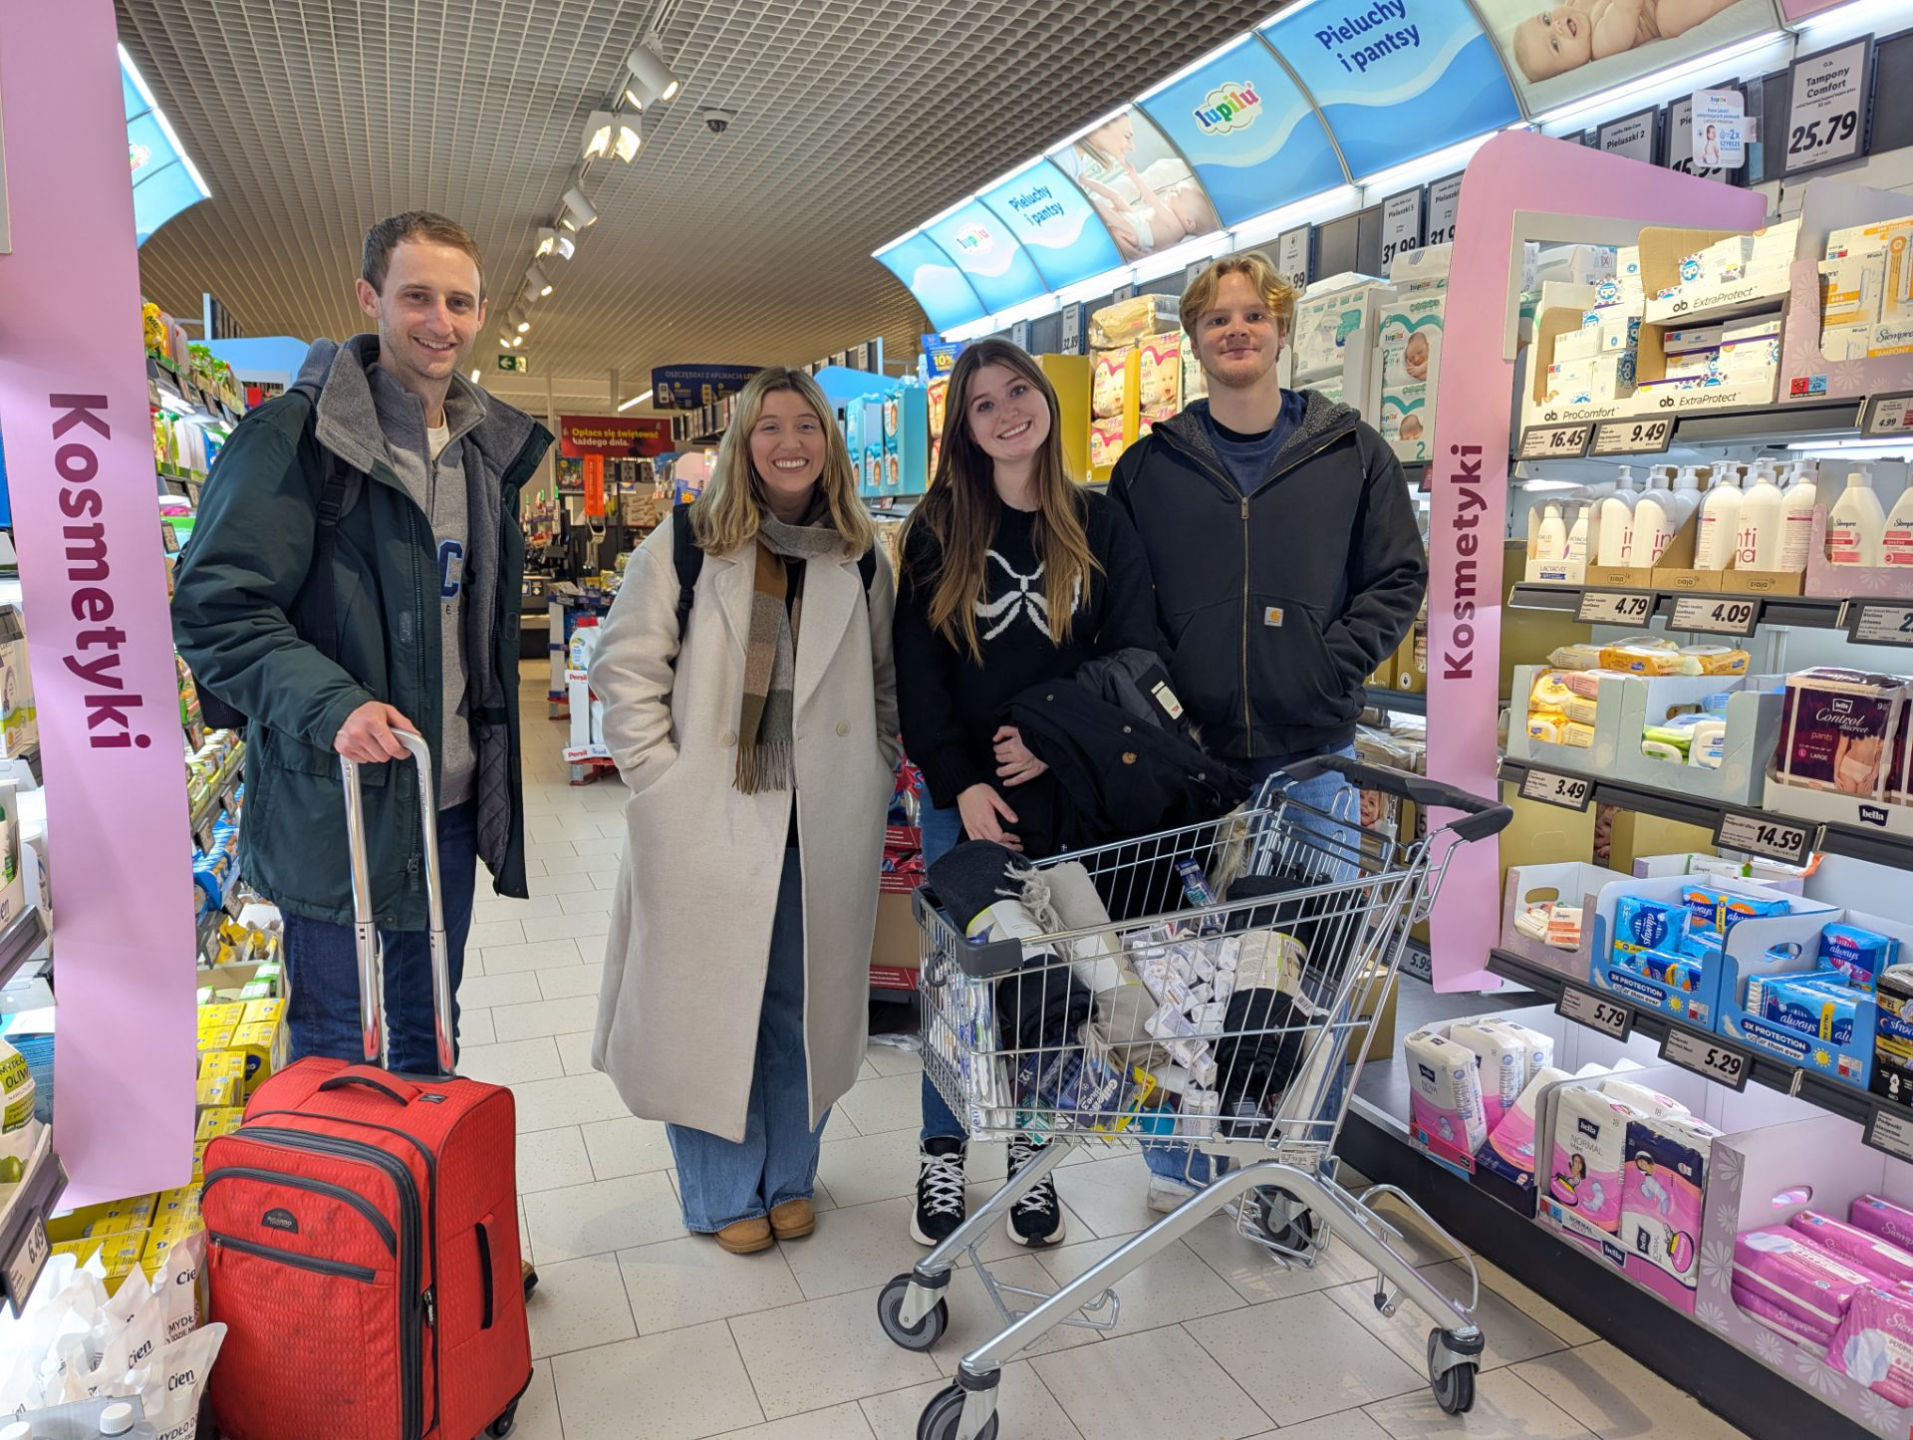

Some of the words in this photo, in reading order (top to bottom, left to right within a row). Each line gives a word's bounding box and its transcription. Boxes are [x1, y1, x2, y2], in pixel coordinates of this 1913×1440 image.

[1314, 0, 1406, 50] Pieluchy
[1336, 53, 1352, 72] i
[1350, 24, 1420, 73] pantsy
[1806, 67, 1850, 87] Tampony
[1806, 79, 1847, 98] Comfort
[1194, 88, 1260, 128] lupilu
[1606, 132, 1640, 150] Pieluszki
[1640, 130, 1646, 139] 2
[1788, 110, 1858, 154] 25.79
[1008, 185, 1053, 212] Pieluchy
[1032, 202, 1064, 227] pantsy
[1673, 301, 1688, 312] ob
[1693, 287, 1753, 309] ExtraProtect
[1660, 395, 1675, 408] ob
[1679, 392, 1738, 406] ExtraProtect
[1544, 412, 1558, 422] ob
[1563, 407, 1615, 421] ProComfort
[1550, 429, 1585, 448] 16.45
[1631, 423, 1666, 443] 9.49
[1416, 441, 1426, 460] 2
[49, 393, 151, 749] Kosmetyki
[1443, 444, 1488, 680] Kosmetyki
[1615, 597, 1648, 615] 4.79
[1711, 604, 1751, 624] 4.09
[569, 674, 588, 682] Persil
[1815, 707, 1866, 727] Control
[568, 750, 588, 758] Persil
[1810, 752, 1828, 761] LARGE
[1555, 779, 1586, 799] 3.49
[1862, 808, 1885, 821] bella
[1756, 825, 1803, 851] 14.59
[1829, 945, 1860, 961] always
[1620, 977, 1663, 998] PROTECTION
[1631, 990, 1644, 1001] than
[1645, 995, 1660, 1006] ever
[1593, 1003, 1625, 1028] 5.79
[1780, 1012, 1817, 1034] always
[1755, 1024, 1807, 1050] PROTECTION
[1767, 1040, 1782, 1052] than
[1782, 1046, 1802, 1059] ever
[1704, 1047, 1742, 1075] 5.29
[1580, 1120, 1596, 1135] bella
[1570, 1134, 1603, 1157] NORMAL
[1638, 1230, 1648, 1252] bella
[1604, 1243, 1623, 1262] bella
[176, 1268, 197, 1286] Cie
[128, 1340, 152, 1370] Cien
[168, 1369, 195, 1392] Cien
